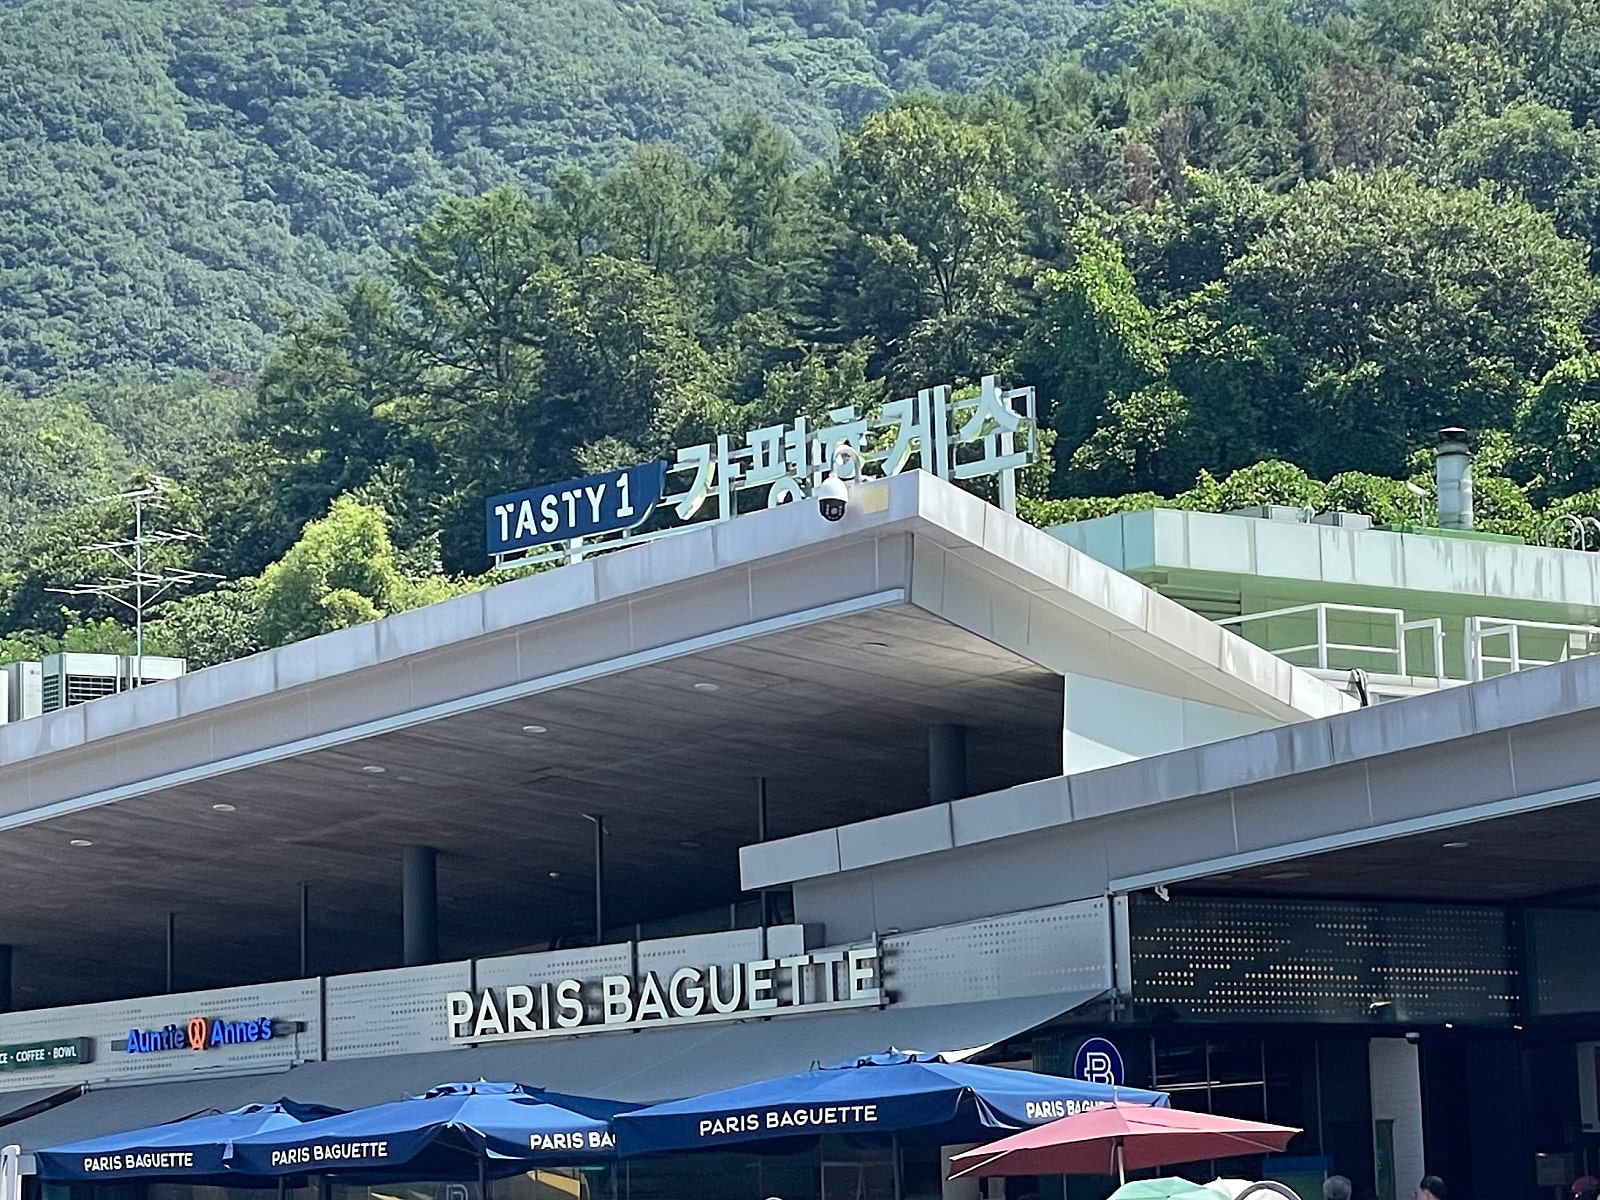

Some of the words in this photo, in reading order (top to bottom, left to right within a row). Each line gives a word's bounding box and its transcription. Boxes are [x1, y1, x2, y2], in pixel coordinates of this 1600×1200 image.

[495, 482, 602, 542] TASTY
[615, 472, 635, 518] 1
[446, 979, 584, 1038] PARIS
[602, 949, 877, 1024] BAGUETTE
[127, 1025, 185, 1053] Auntie
[211, 1017, 273, 1045] Anne's
[15, 1048, 45, 1062] COFFEE
[53, 1046, 77, 1059] BOWL
[699, 1114, 760, 1137] PARIS
[765, 1104, 878, 1129] BAGUETTE
[1025, 1101, 1065, 1119] PARIS
[530, 1133, 584, 1150] PARIS
[588, 1131, 616, 1149] BA
[83, 1156, 122, 1172] PARIS
[125, 1152, 194, 1169] BAGUETTE
[271, 1149, 310, 1167] PARIS
[313, 1142, 388, 1161] BAGUETTE
